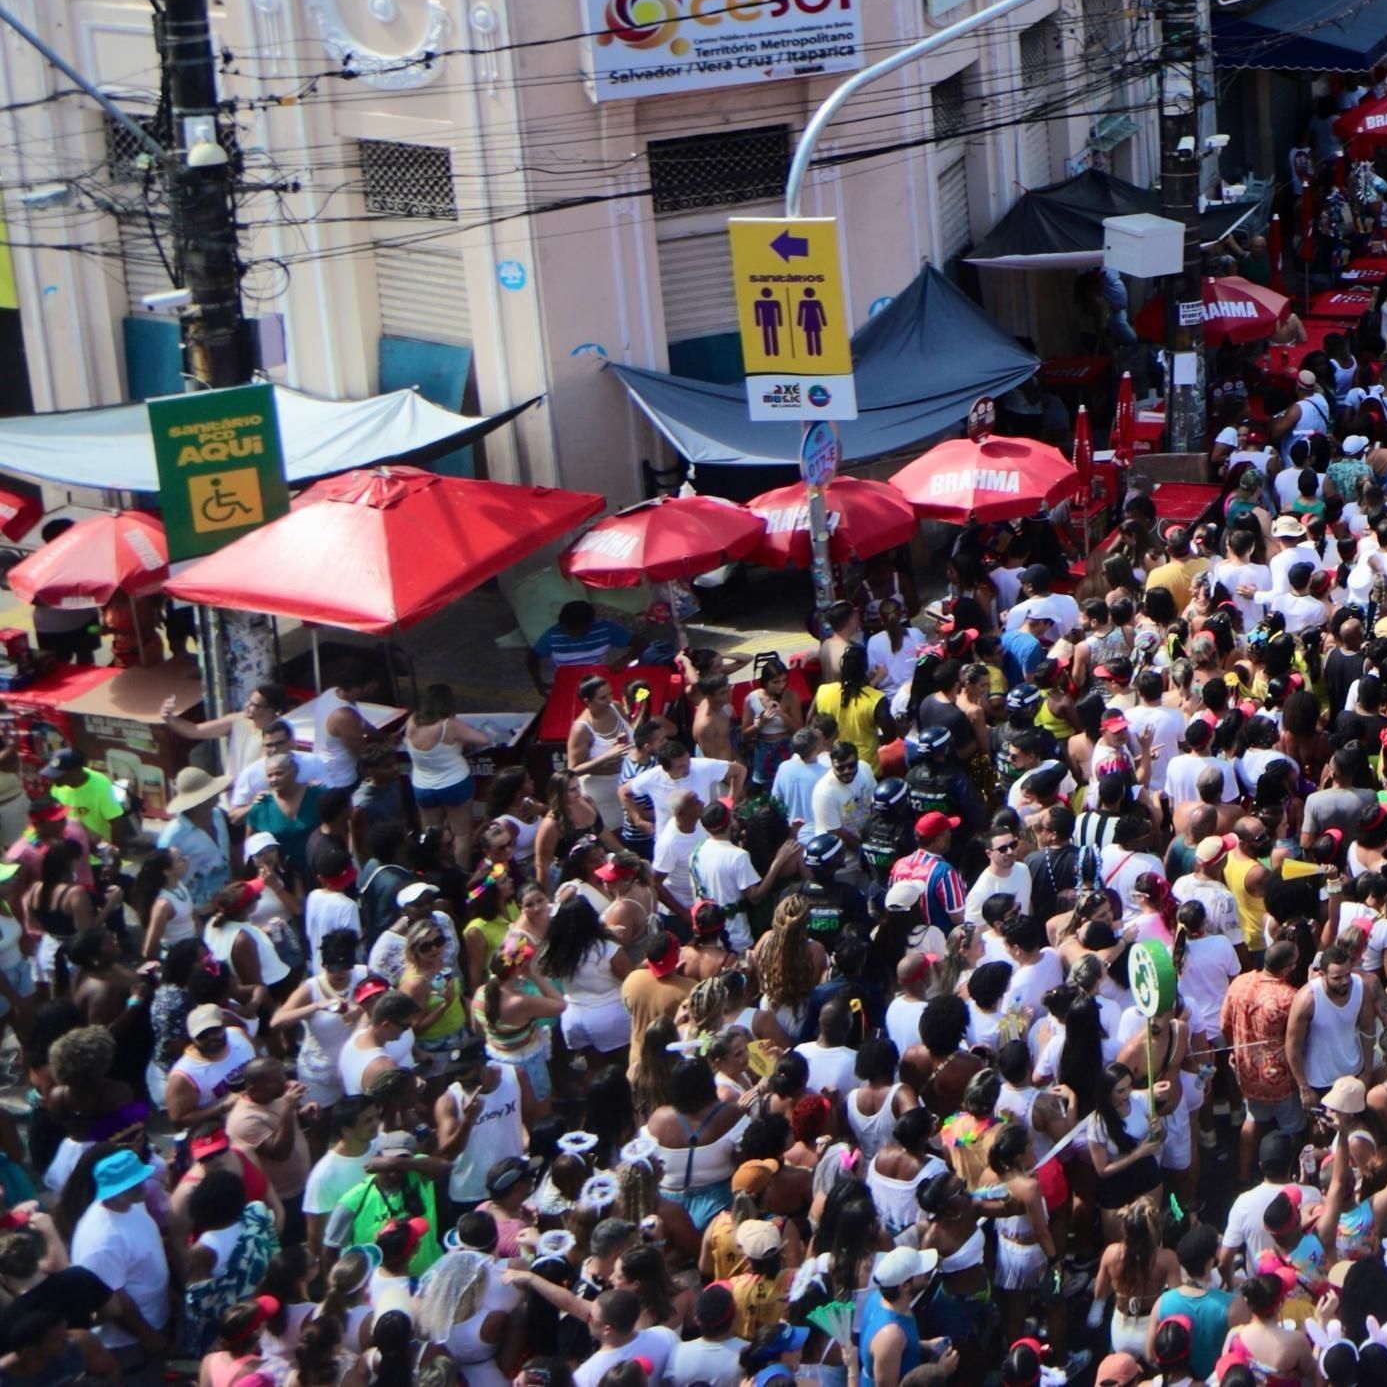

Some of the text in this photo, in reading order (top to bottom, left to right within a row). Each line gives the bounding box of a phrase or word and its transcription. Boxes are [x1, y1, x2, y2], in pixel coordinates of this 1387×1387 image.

[695, 43, 757, 59] Território
[761, 31, 855, 49] Metropolitano
[609, 65, 683, 85] Salvador
[696, 60, 733, 74] Vera
[737, 56, 773, 69] Cruz
[787, 44, 856, 63] Itaparica
[1199, 300, 1259, 321] RAHMA
[198, 429, 236, 443] PCD
[929, 469, 1020, 496] BRAHMA
